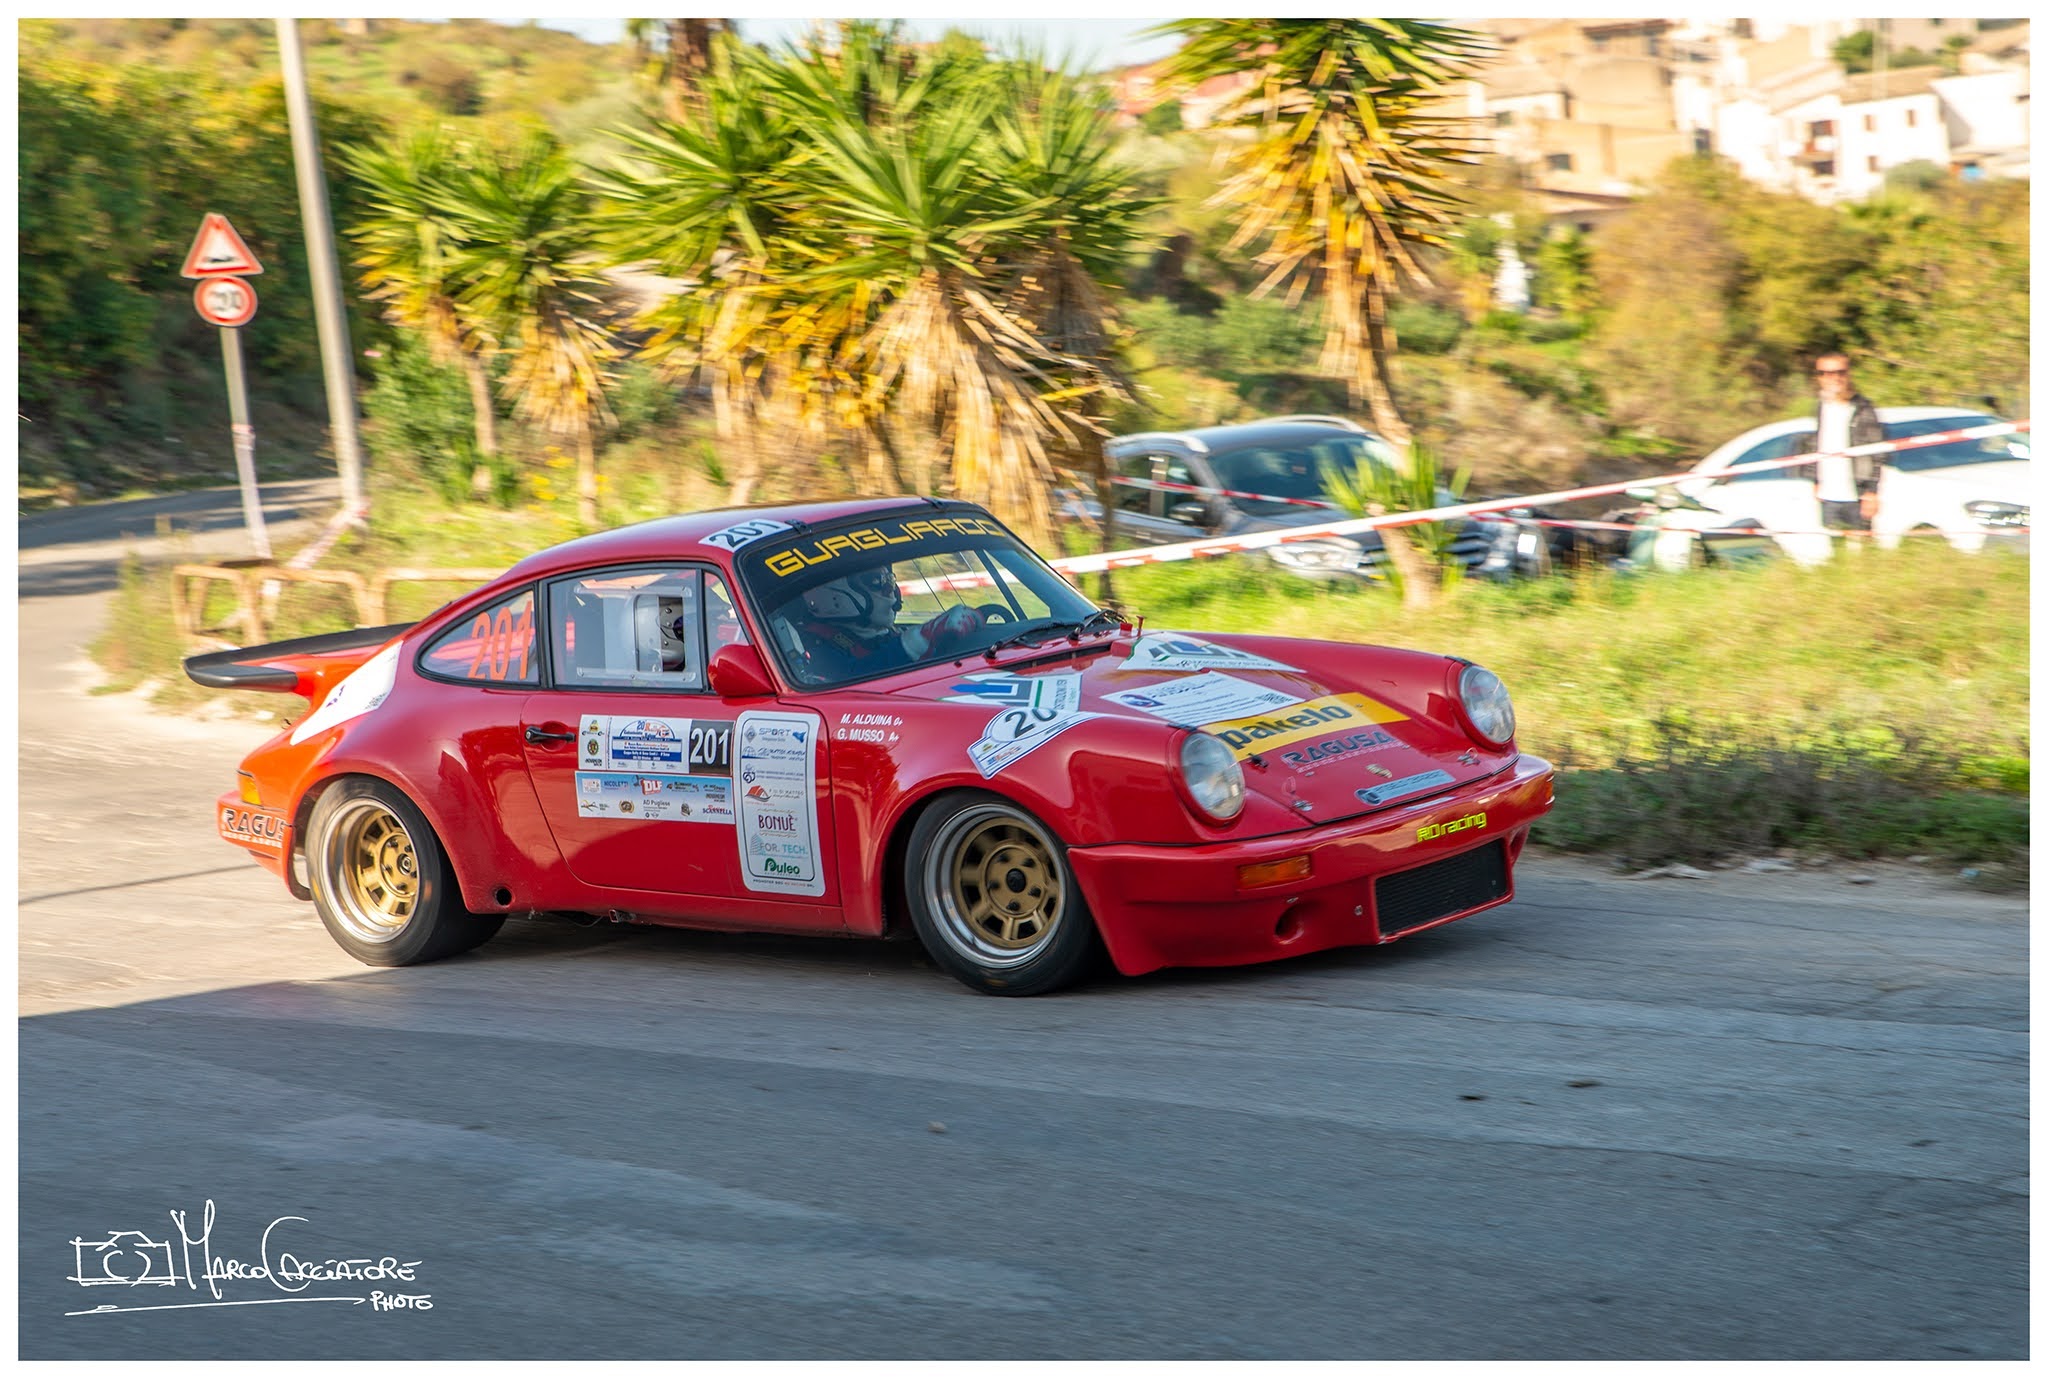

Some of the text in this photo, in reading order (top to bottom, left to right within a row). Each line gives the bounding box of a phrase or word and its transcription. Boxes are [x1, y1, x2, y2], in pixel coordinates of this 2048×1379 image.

[709, 521, 775, 548] 201
[467, 600, 533, 680] 201
[840, 713, 851, 724] M.
[852, 714, 892, 726] ALDUINA
[1215, 705, 1353, 750] pakelo
[759, 728, 791, 737] SPORT
[837, 728, 848, 740] G.
[849, 729, 885, 742] MUSSO
[689, 727, 729, 765] 201
[1281, 731, 1396, 769] RAGUSA
[643, 780, 663, 792] DLF
[758, 814, 796, 832] BONUÈ
[760, 842, 809, 855] FOR. TECH.
[764, 857, 801, 875] Puleo
